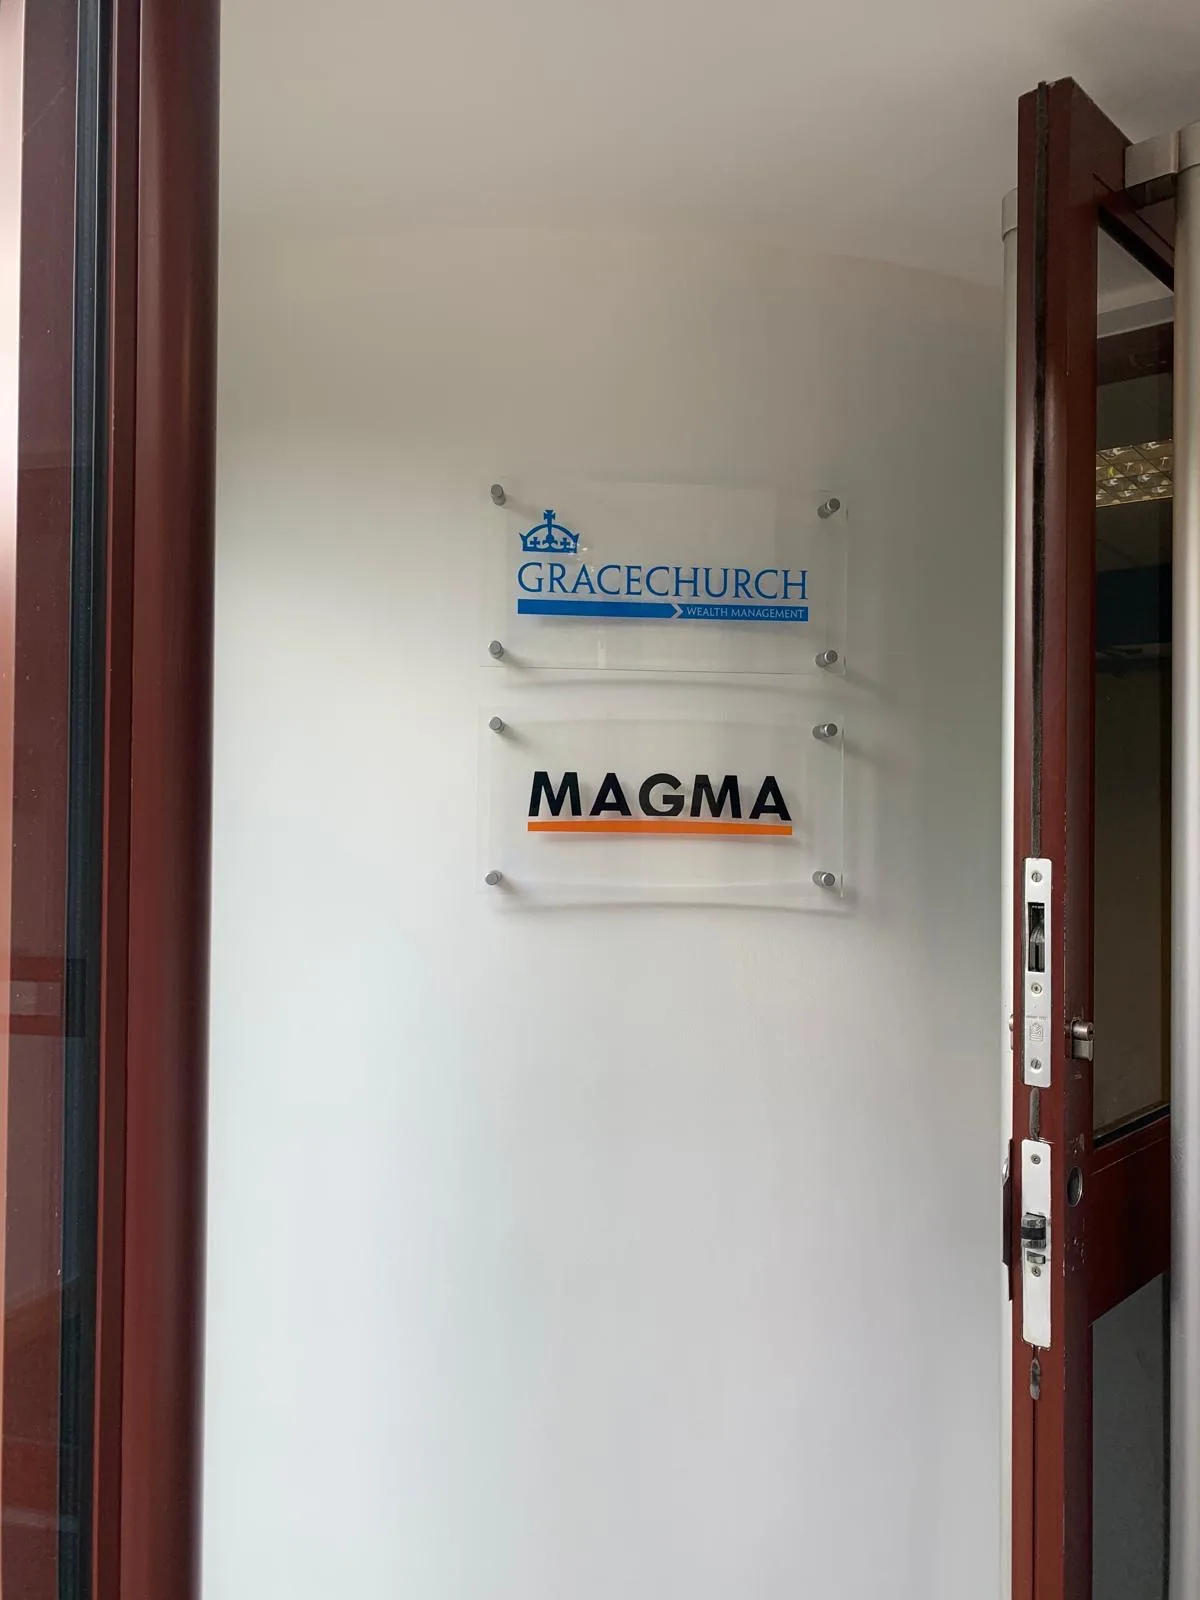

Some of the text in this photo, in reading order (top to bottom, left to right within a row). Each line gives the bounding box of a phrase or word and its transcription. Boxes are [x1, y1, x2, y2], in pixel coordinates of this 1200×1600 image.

[517, 562, 808, 600] GRACECHURCH
[686, 606, 804, 619] WEALTH MANAGEMENT
[528, 771, 791, 821] MAGMA
